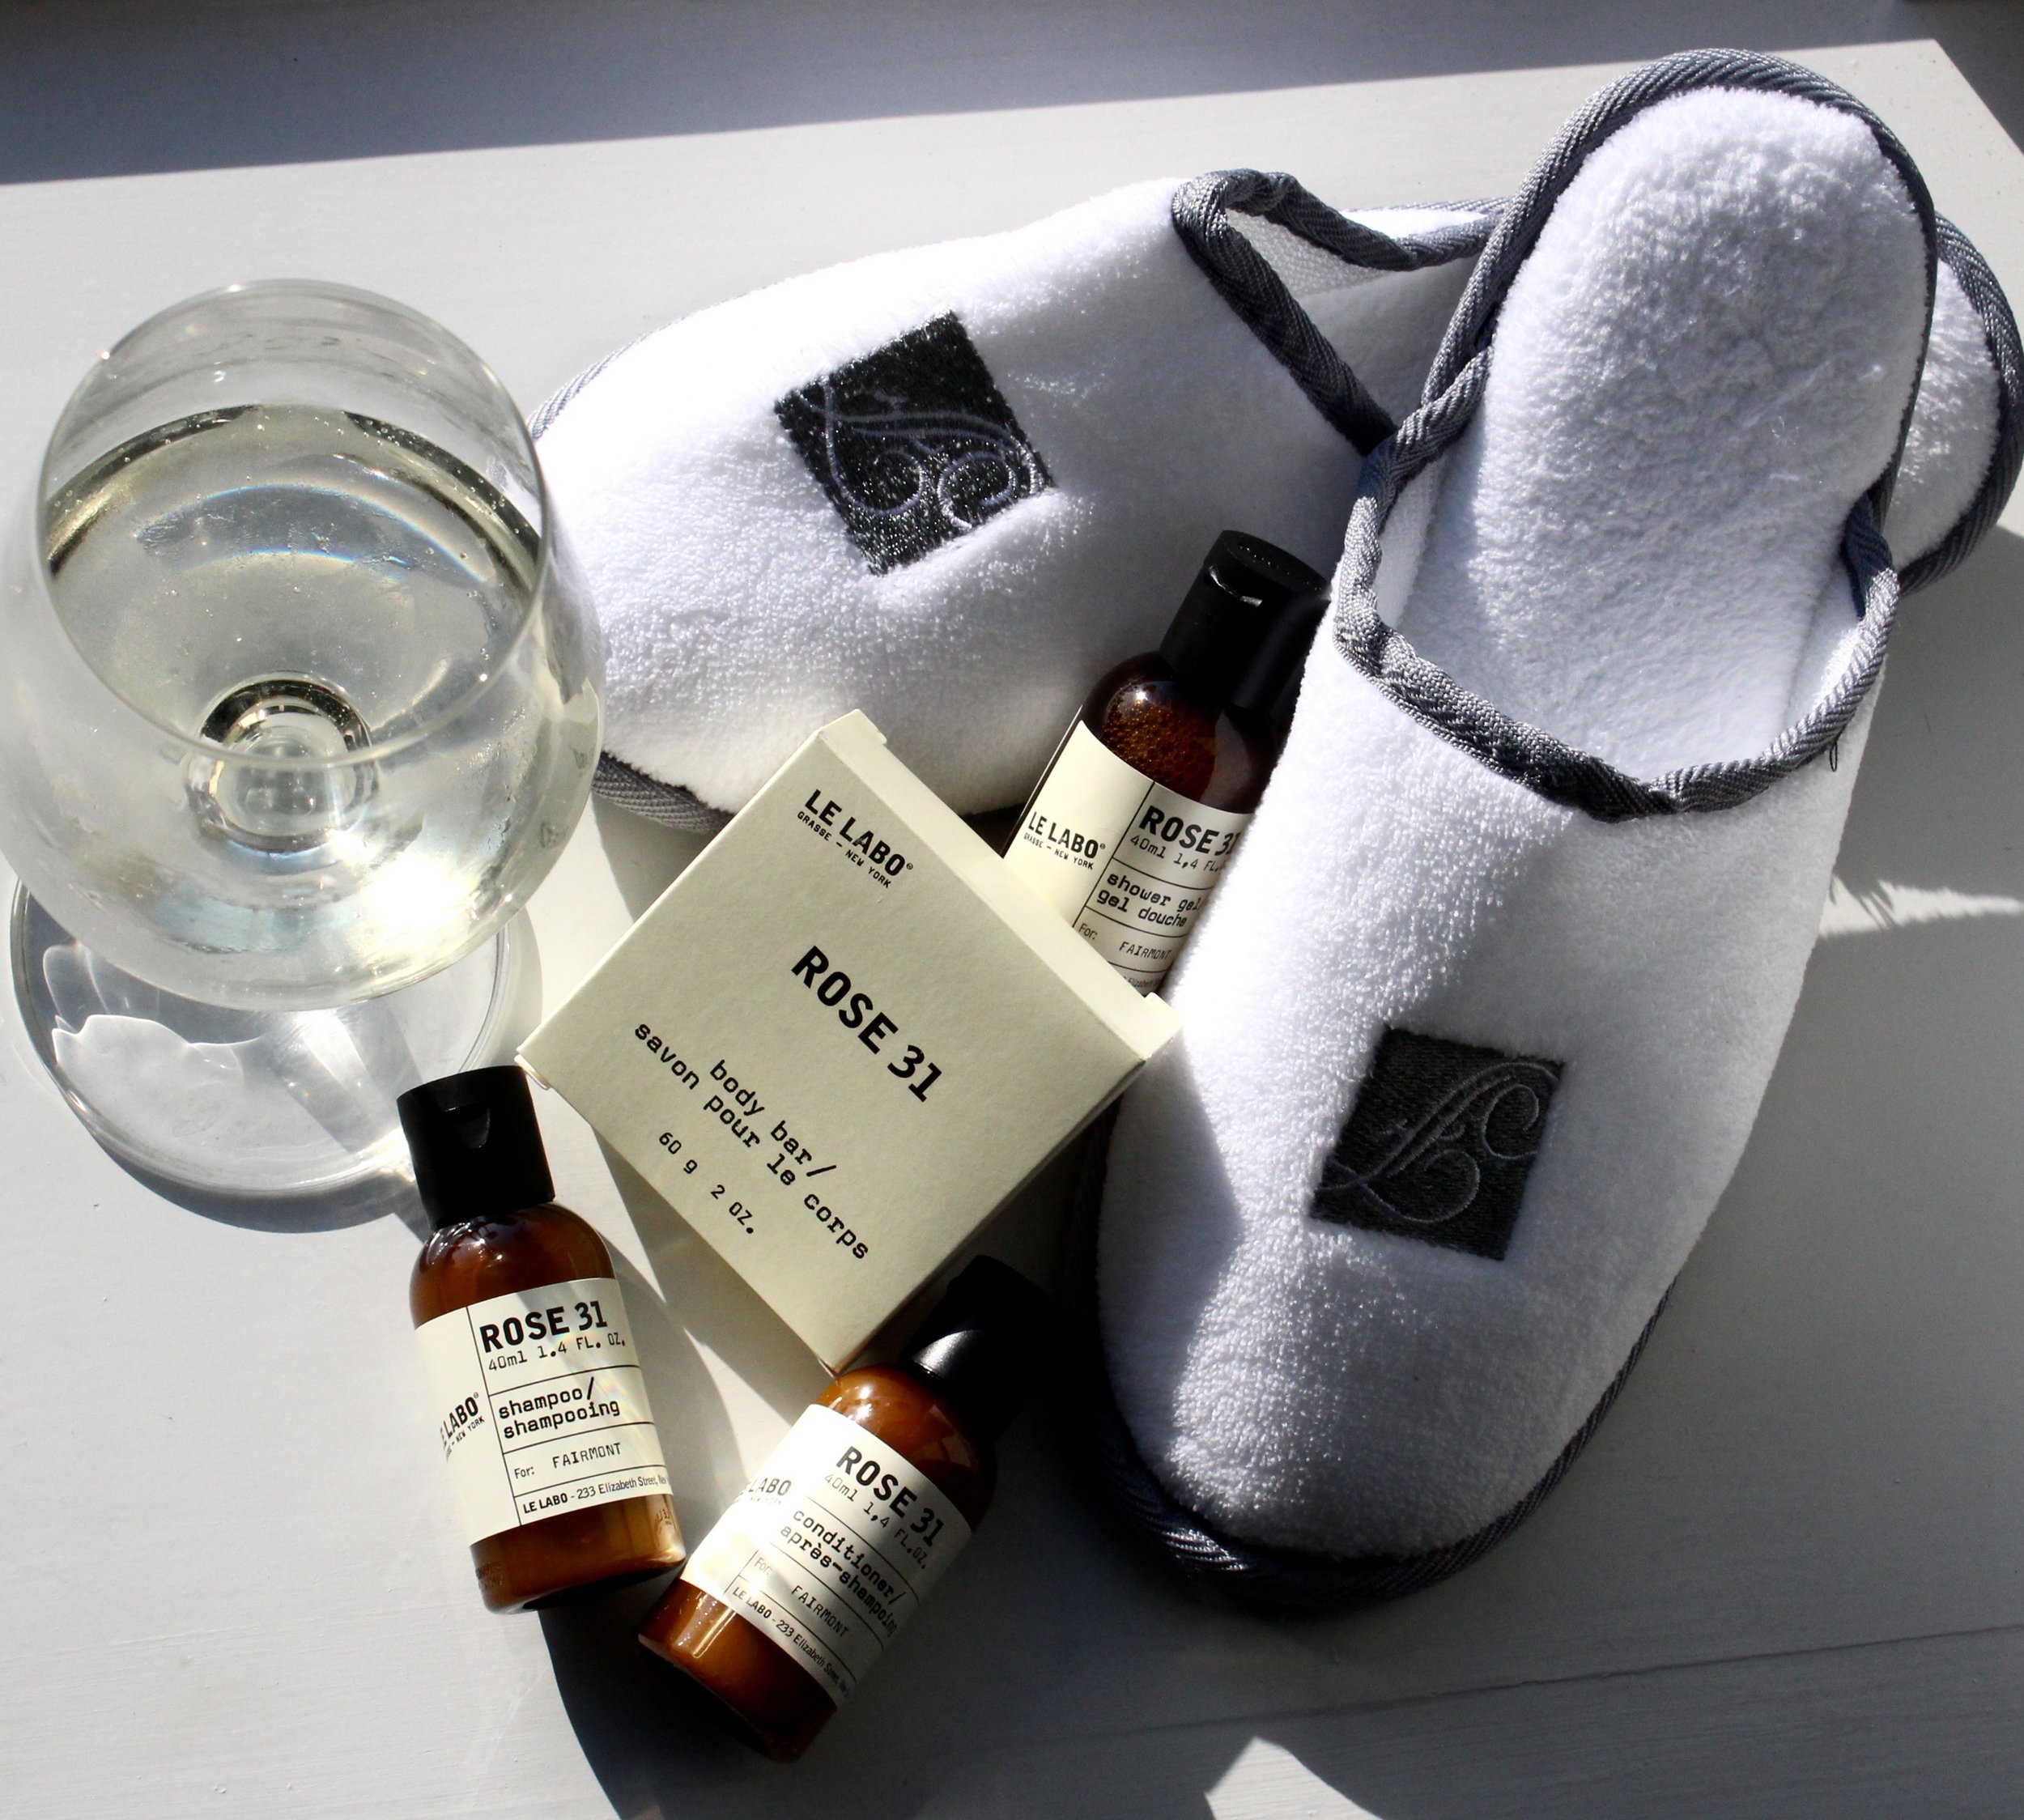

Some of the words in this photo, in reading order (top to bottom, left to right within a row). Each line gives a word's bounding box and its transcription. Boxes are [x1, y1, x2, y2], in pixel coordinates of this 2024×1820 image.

[805, 789, 843, 827] LE
[1028, 811, 1047, 836] LE
[797, 811, 832, 841] GRASSE
[845, 849, 865, 867] NEW
[868, 867, 891, 889] YORK
[1130, 835, 1165, 859] 40ml
[1138, 806, 1220, 855] ROSE
[1054, 849, 1069, 860] NEW
[1073, 854, 1094, 870] YORK
[1097, 890, 1128, 912] gel
[1138, 907, 1187, 928] douche
[1107, 873, 1171, 907] shower
[1177, 896, 1201, 912] gel
[1078, 923, 1099, 940] For:
[1119, 942, 1172, 960] FAIRMONT
[791, 945, 899, 1055] ROSE
[887, 1044, 942, 1103] 31
[710, 1059, 764, 1116] body
[771, 1120, 836, 1177] bar/
[635, 1023, 699, 1090] savon
[704, 1095, 760, 1147] pour
[767, 1153, 795, 1186] le
[804, 1194, 869, 1259] corps
[658, 1132, 682, 1155] 60
[683, 1159, 698, 1175] g
[710, 1184, 725, 1200] 2
[729, 1201, 754, 1234] OZ.
[479, 1306, 570, 1353] ROSE
[574, 1300, 608, 1330] 31
[488, 1350, 528, 1371] 40ml
[538, 1342, 568, 1359] 1.4
[576, 1336, 602, 1350] FL.
[499, 1376, 594, 1419] shampoo/
[467, 1415, 485, 1431] YORK
[503, 1400, 620, 1439] shampooing
[514, 1465, 535, 1479] For:
[552, 1442, 622, 1469] FAIRMONT
[523, 1501, 537, 1514] LE
[538, 1493, 568, 1509] LABO
[576, 1486, 596, 1499] 233
[597, 1478, 637, 1495] Elizabeth
[824, 1473, 858, 1502] 40ml
[836, 1445, 917, 1519] ROSE
[911, 1507, 945, 1548] 31
[793, 1510, 907, 1605] conditioner/
[754, 1558, 773, 1577] For:
[791, 1584, 849, 1639] FAIRMONT
[733, 1587, 746, 1601] LE
[747, 1594, 772, 1619] LABO
[776, 1619, 794, 1637] 233
[793, 1633, 826, 1667] Elizabeth
